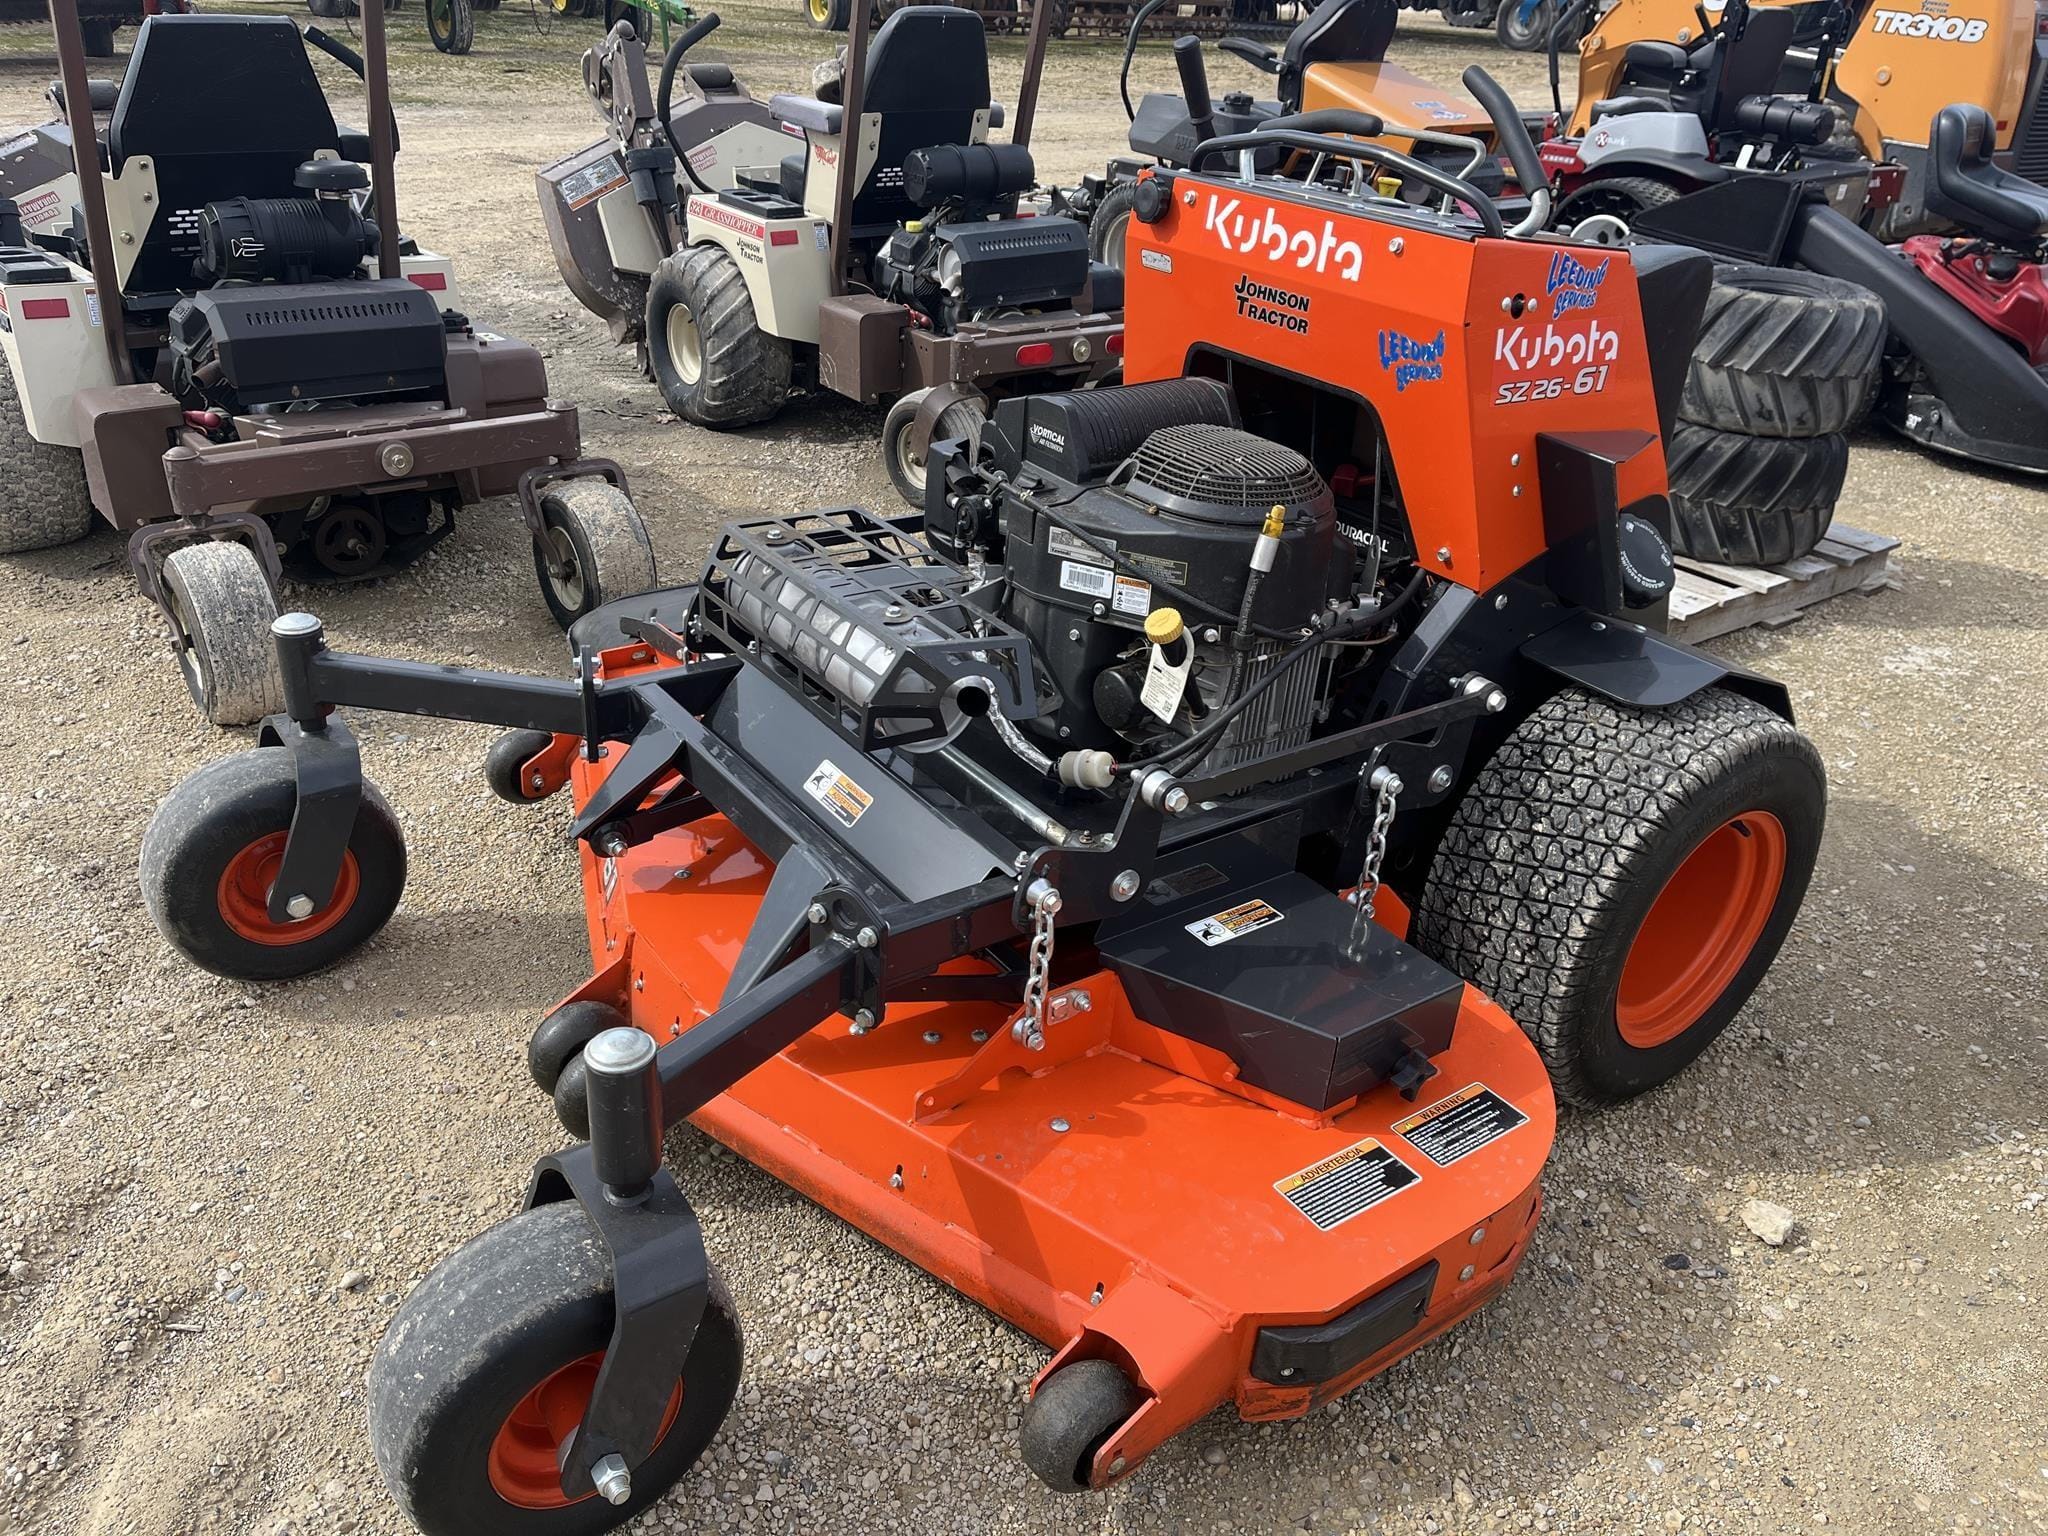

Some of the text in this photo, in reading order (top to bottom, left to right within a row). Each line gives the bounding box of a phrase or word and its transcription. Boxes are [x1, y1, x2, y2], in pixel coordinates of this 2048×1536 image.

[1872, 9, 1989, 43] TR310B
[689, 200, 760, 235] 623 GRASSHOPPER
[736, 237, 761, 252] JOHNSON
[1205, 194, 1363, 282] Kubota
[740, 248, 764, 264] TRACTOR
[1546, 251, 1610, 297] LEEDING
[1234, 275, 1310, 313] JOHNSON
[1553, 290, 1597, 320] SERVICES
[1236, 295, 1309, 334] TRACTOR
[1378, 328, 1446, 371] LEEDING
[1494, 320, 1619, 371] Kubota
[1420, 1095, 1465, 1120] WARNING
[1300, 1147, 1364, 1182] ADVERTENCIA
